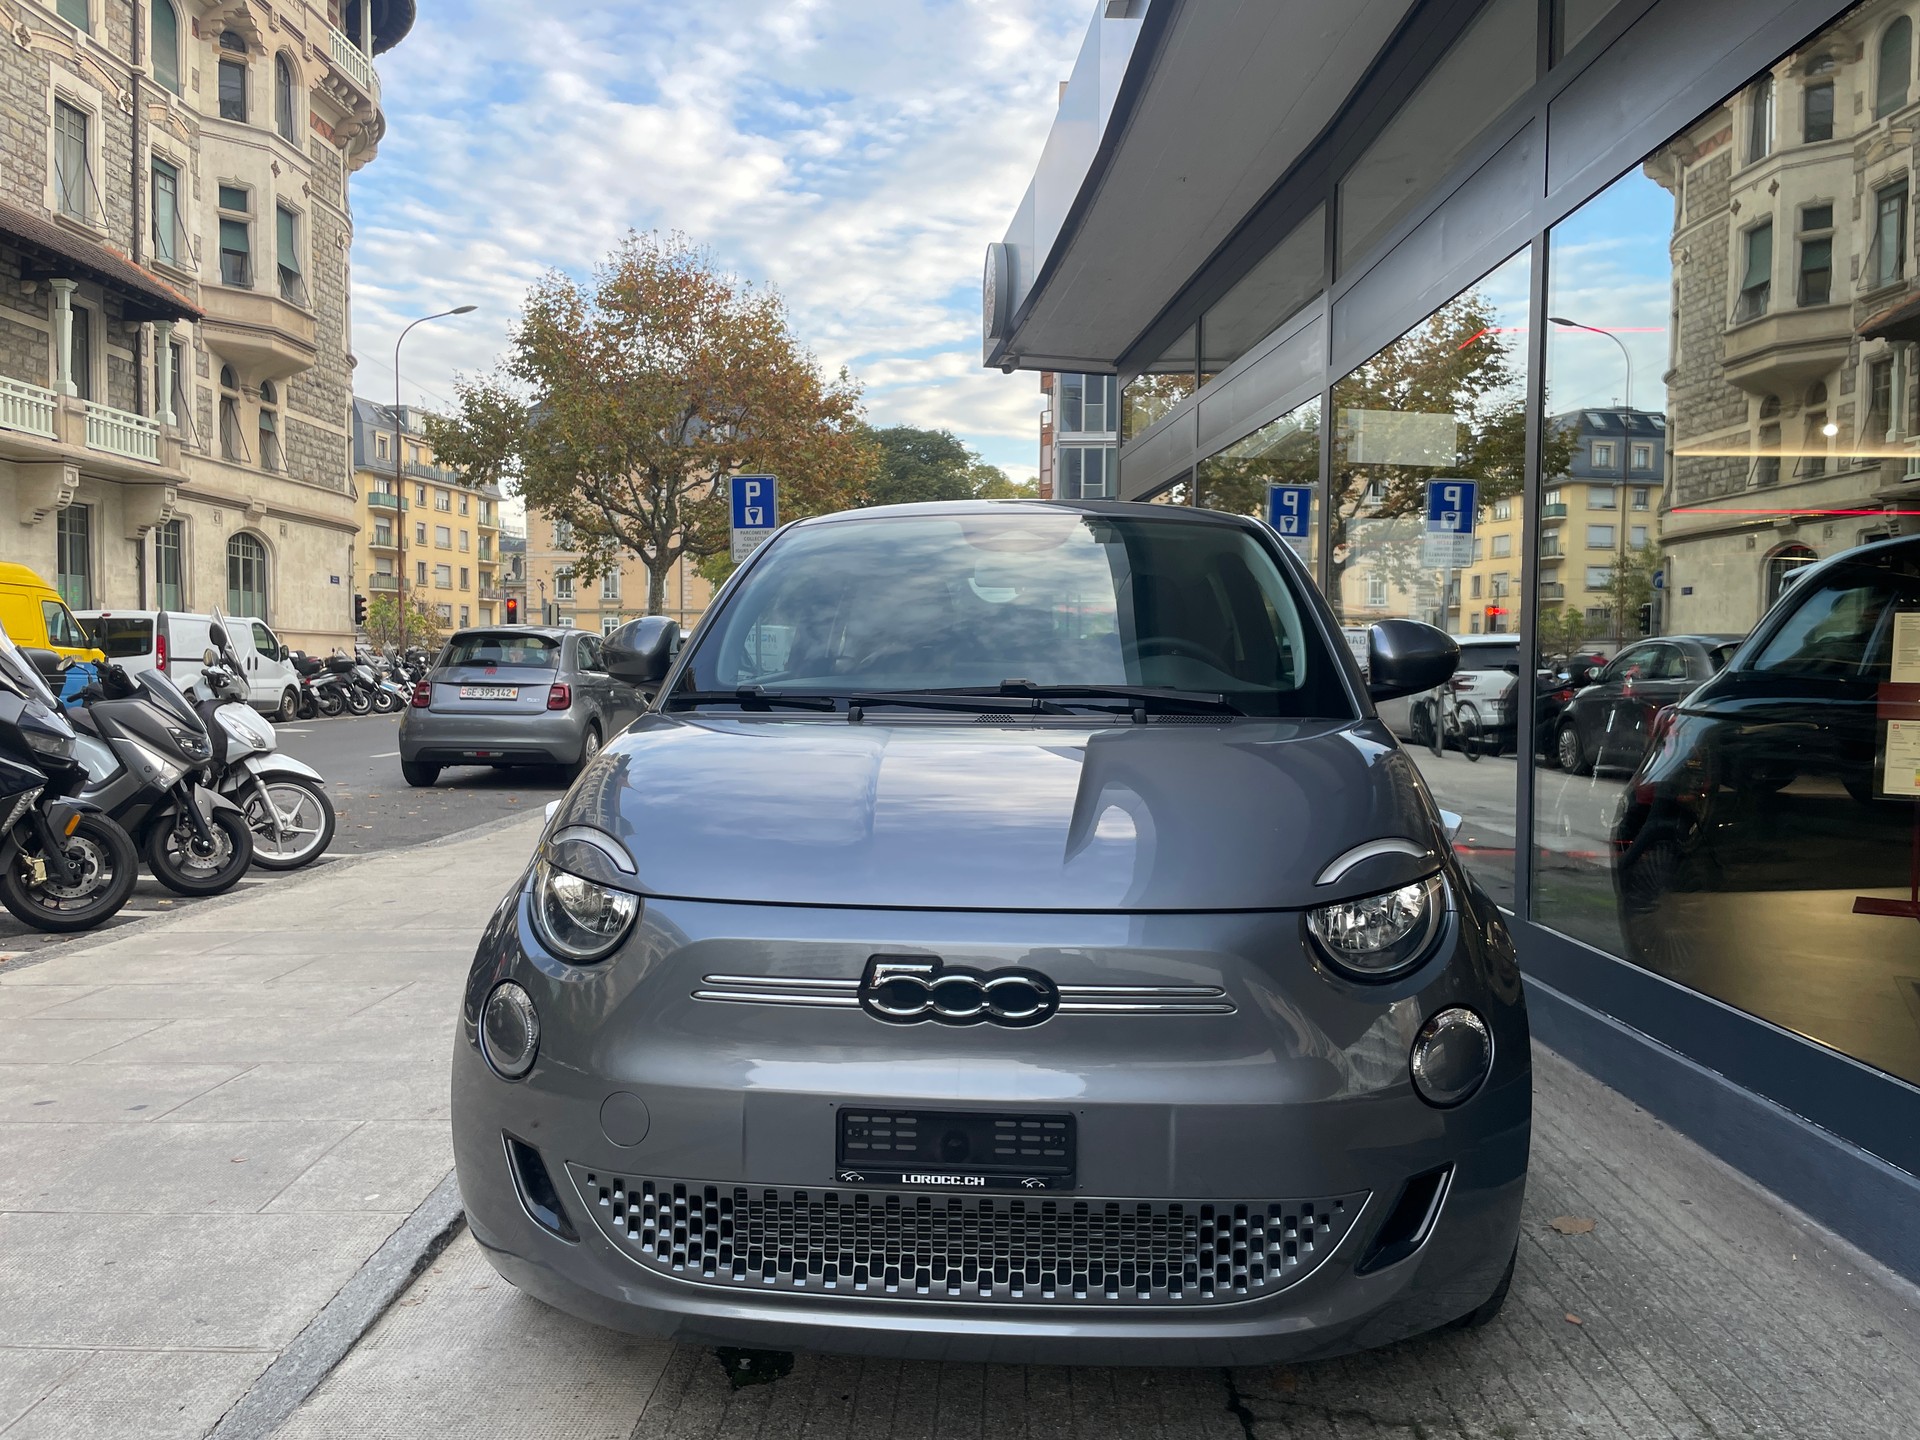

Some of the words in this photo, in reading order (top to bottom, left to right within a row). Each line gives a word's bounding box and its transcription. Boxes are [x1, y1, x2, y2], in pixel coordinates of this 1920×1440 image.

[745, 482, 761, 506] P
[868, 964, 1050, 1019] 500
[902, 1174, 985, 1186] LOROCC.CH
